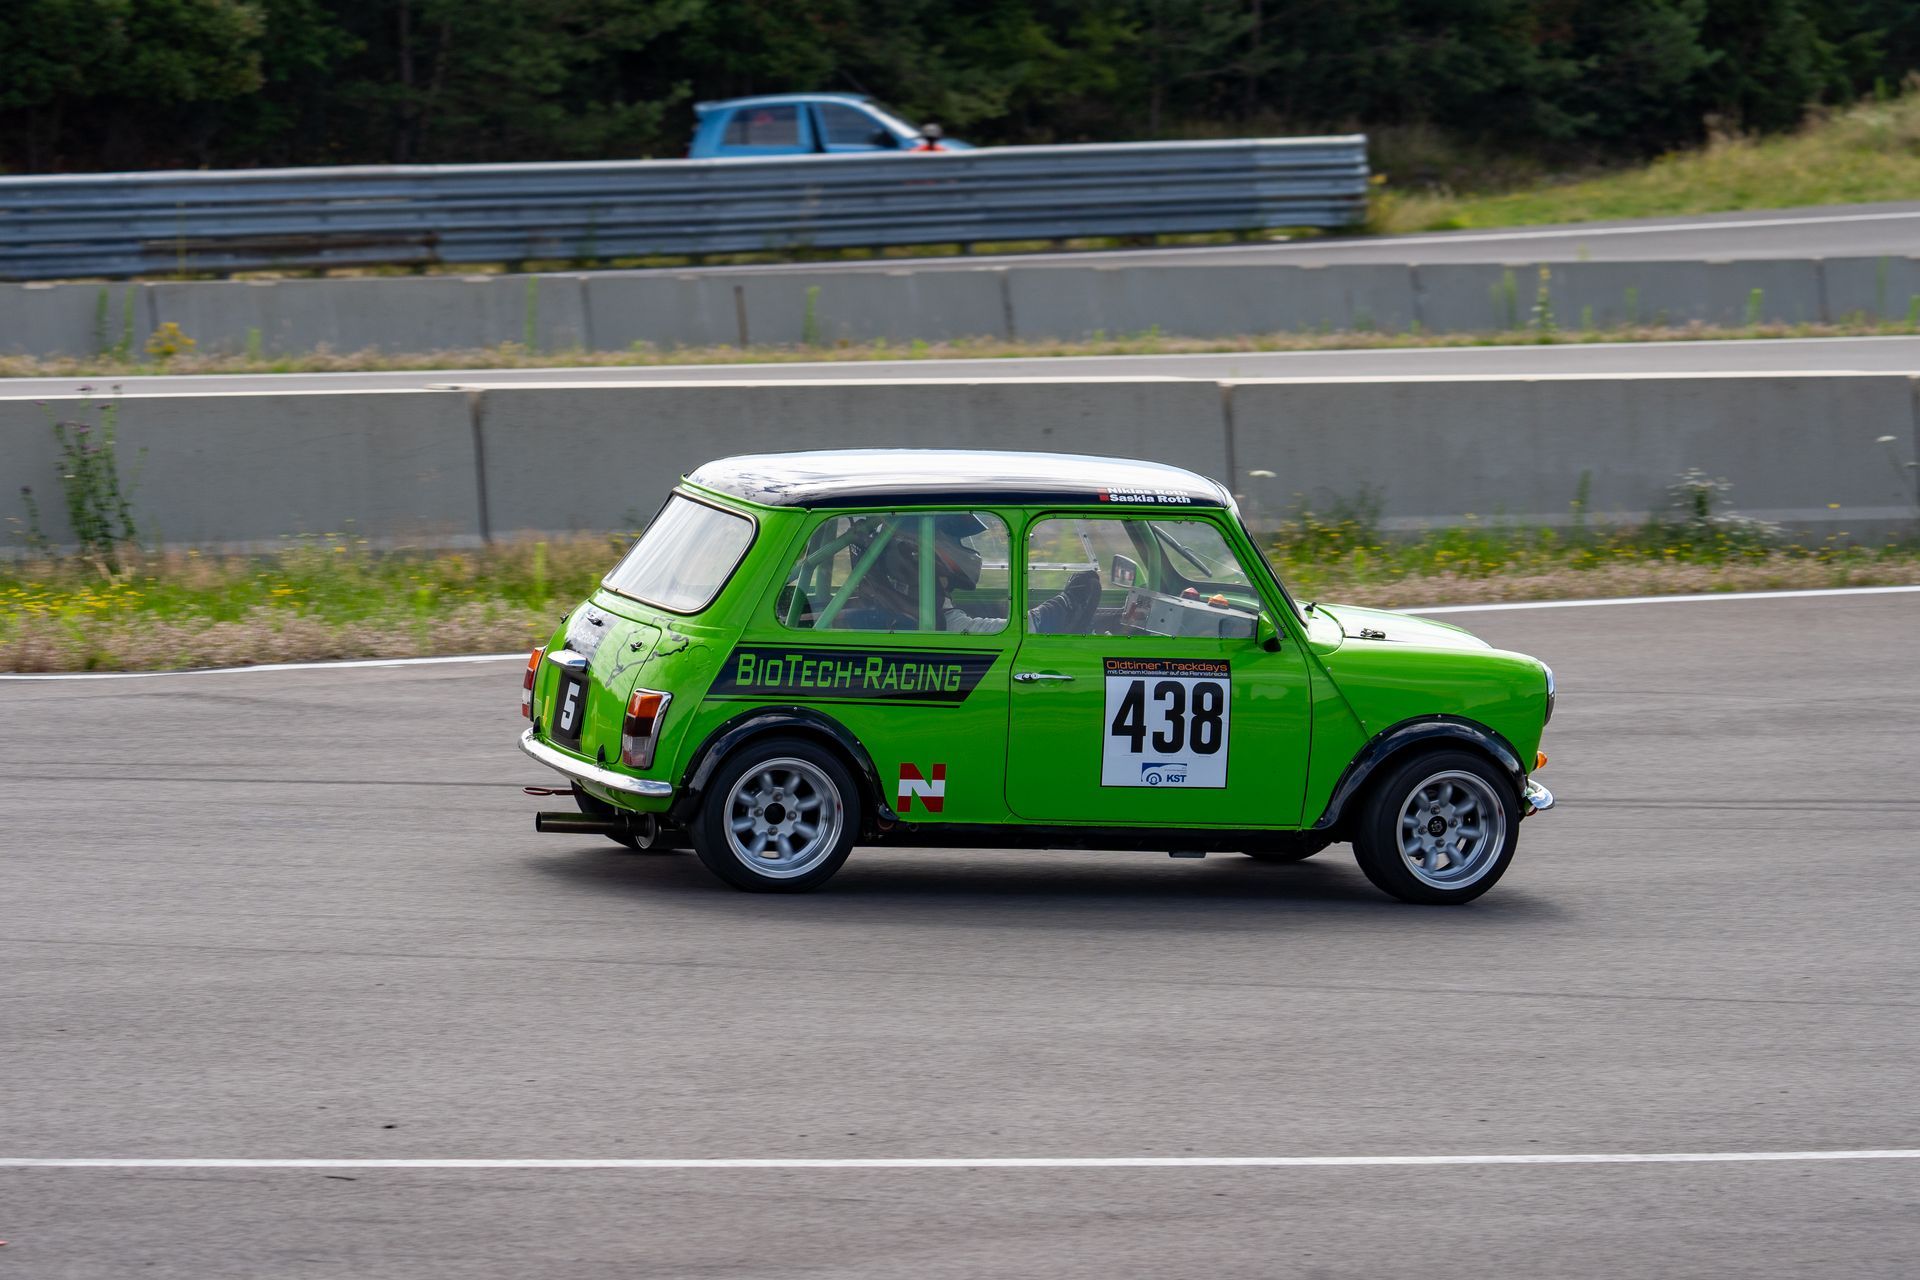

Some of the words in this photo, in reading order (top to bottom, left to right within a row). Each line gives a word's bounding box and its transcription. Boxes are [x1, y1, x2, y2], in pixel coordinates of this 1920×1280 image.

[1109, 494, 1155, 503] Saskia
[1157, 495, 1191, 503] Roth
[1106, 660, 1161, 670] Oldtimer
[1162, 661, 1228, 672] Trackdays
[560, 681, 581, 731] 5
[1111, 680, 1224, 755] 438
[897, 762, 947, 813] N
[1166, 774, 1187, 783] KST
